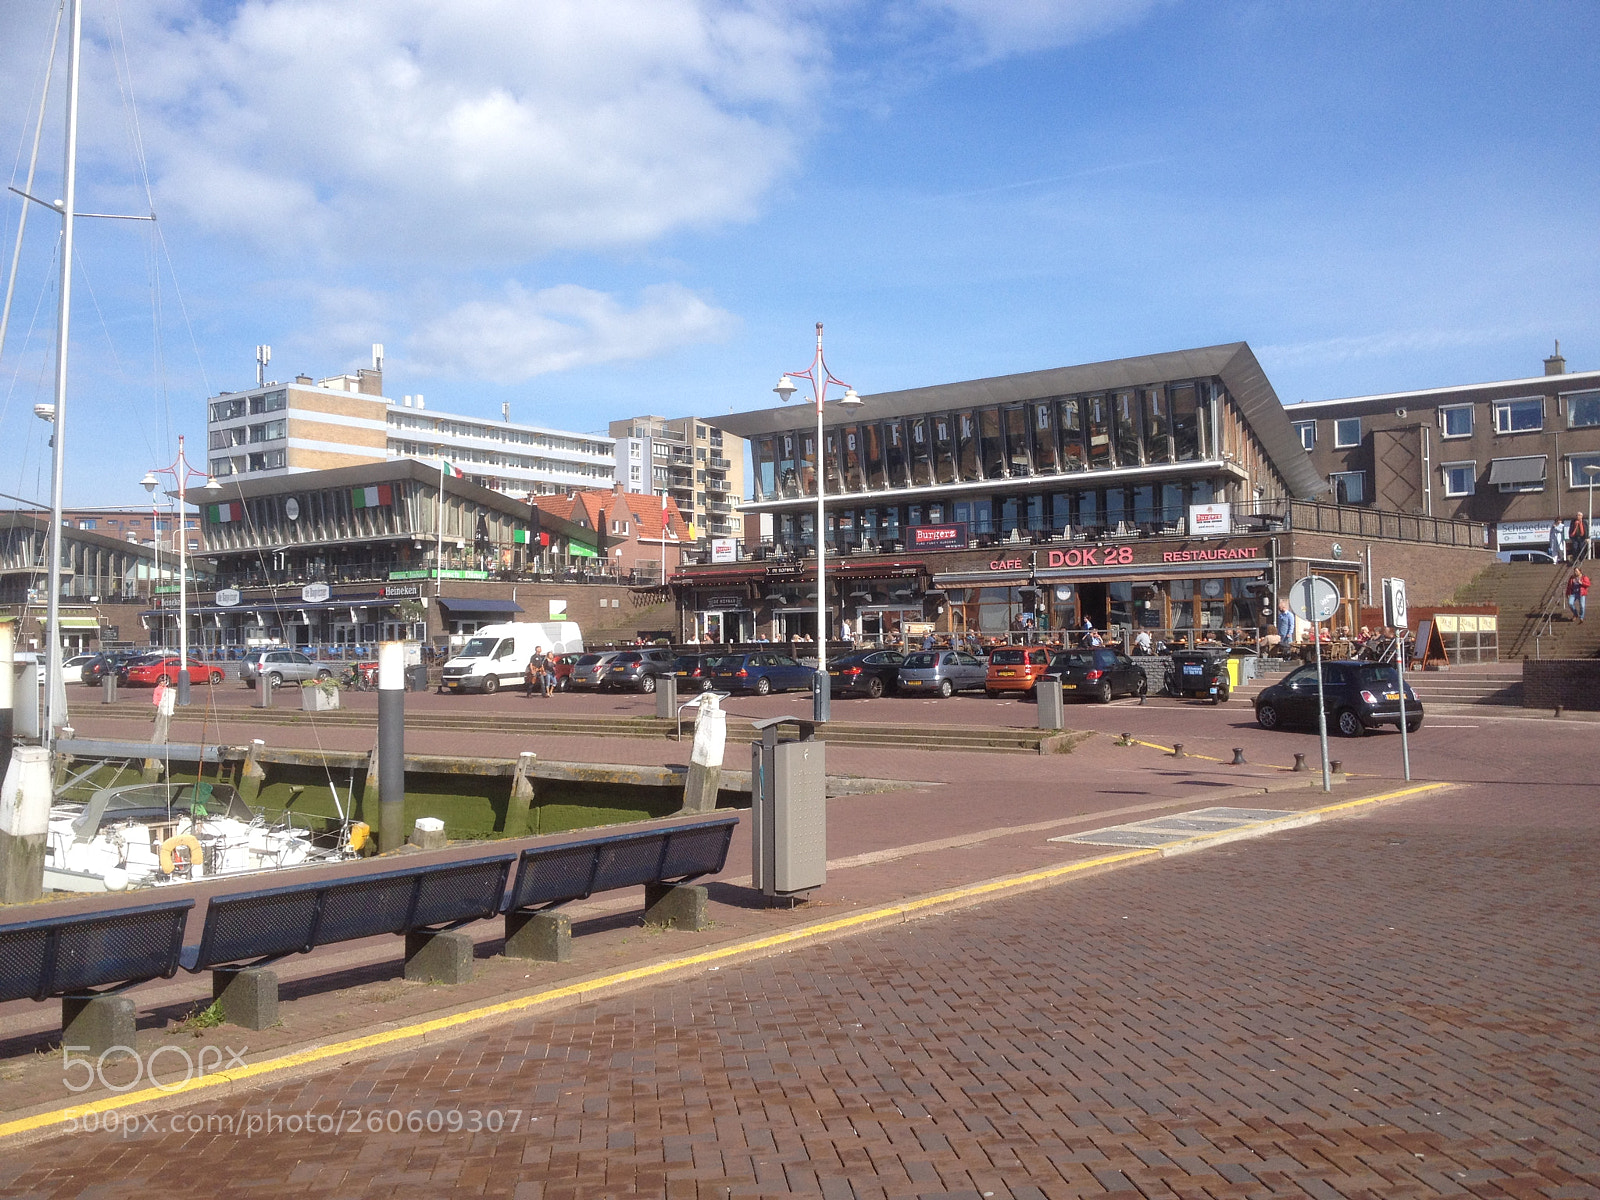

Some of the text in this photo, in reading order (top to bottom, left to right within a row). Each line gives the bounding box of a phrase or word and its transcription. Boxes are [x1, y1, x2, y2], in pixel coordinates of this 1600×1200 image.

[1502, 523, 1549, 532] Schroeder
[916, 530, 956, 540] Burgerz
[990, 547, 1258, 570] CAFÉ DOK 28 RESTAURANT
[384, 586, 417, 596] Heineken
